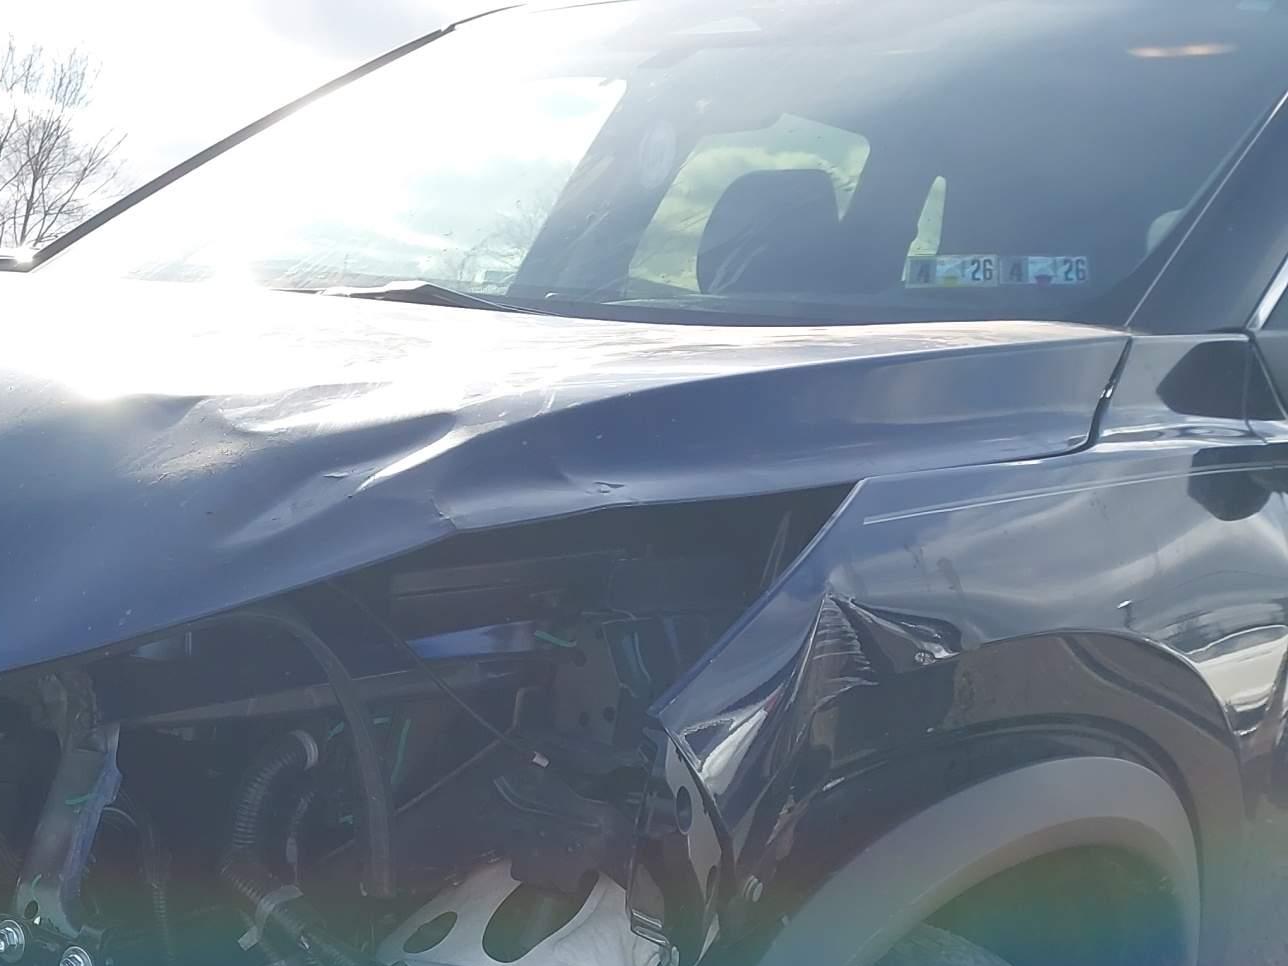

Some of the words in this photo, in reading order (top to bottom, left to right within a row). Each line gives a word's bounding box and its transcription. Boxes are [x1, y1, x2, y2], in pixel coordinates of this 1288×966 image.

[917, 263, 930, 284] 4
[970, 258, 994, 281] 26
[1009, 262, 1023, 282] 4
[1063, 258, 1086, 281] 26
